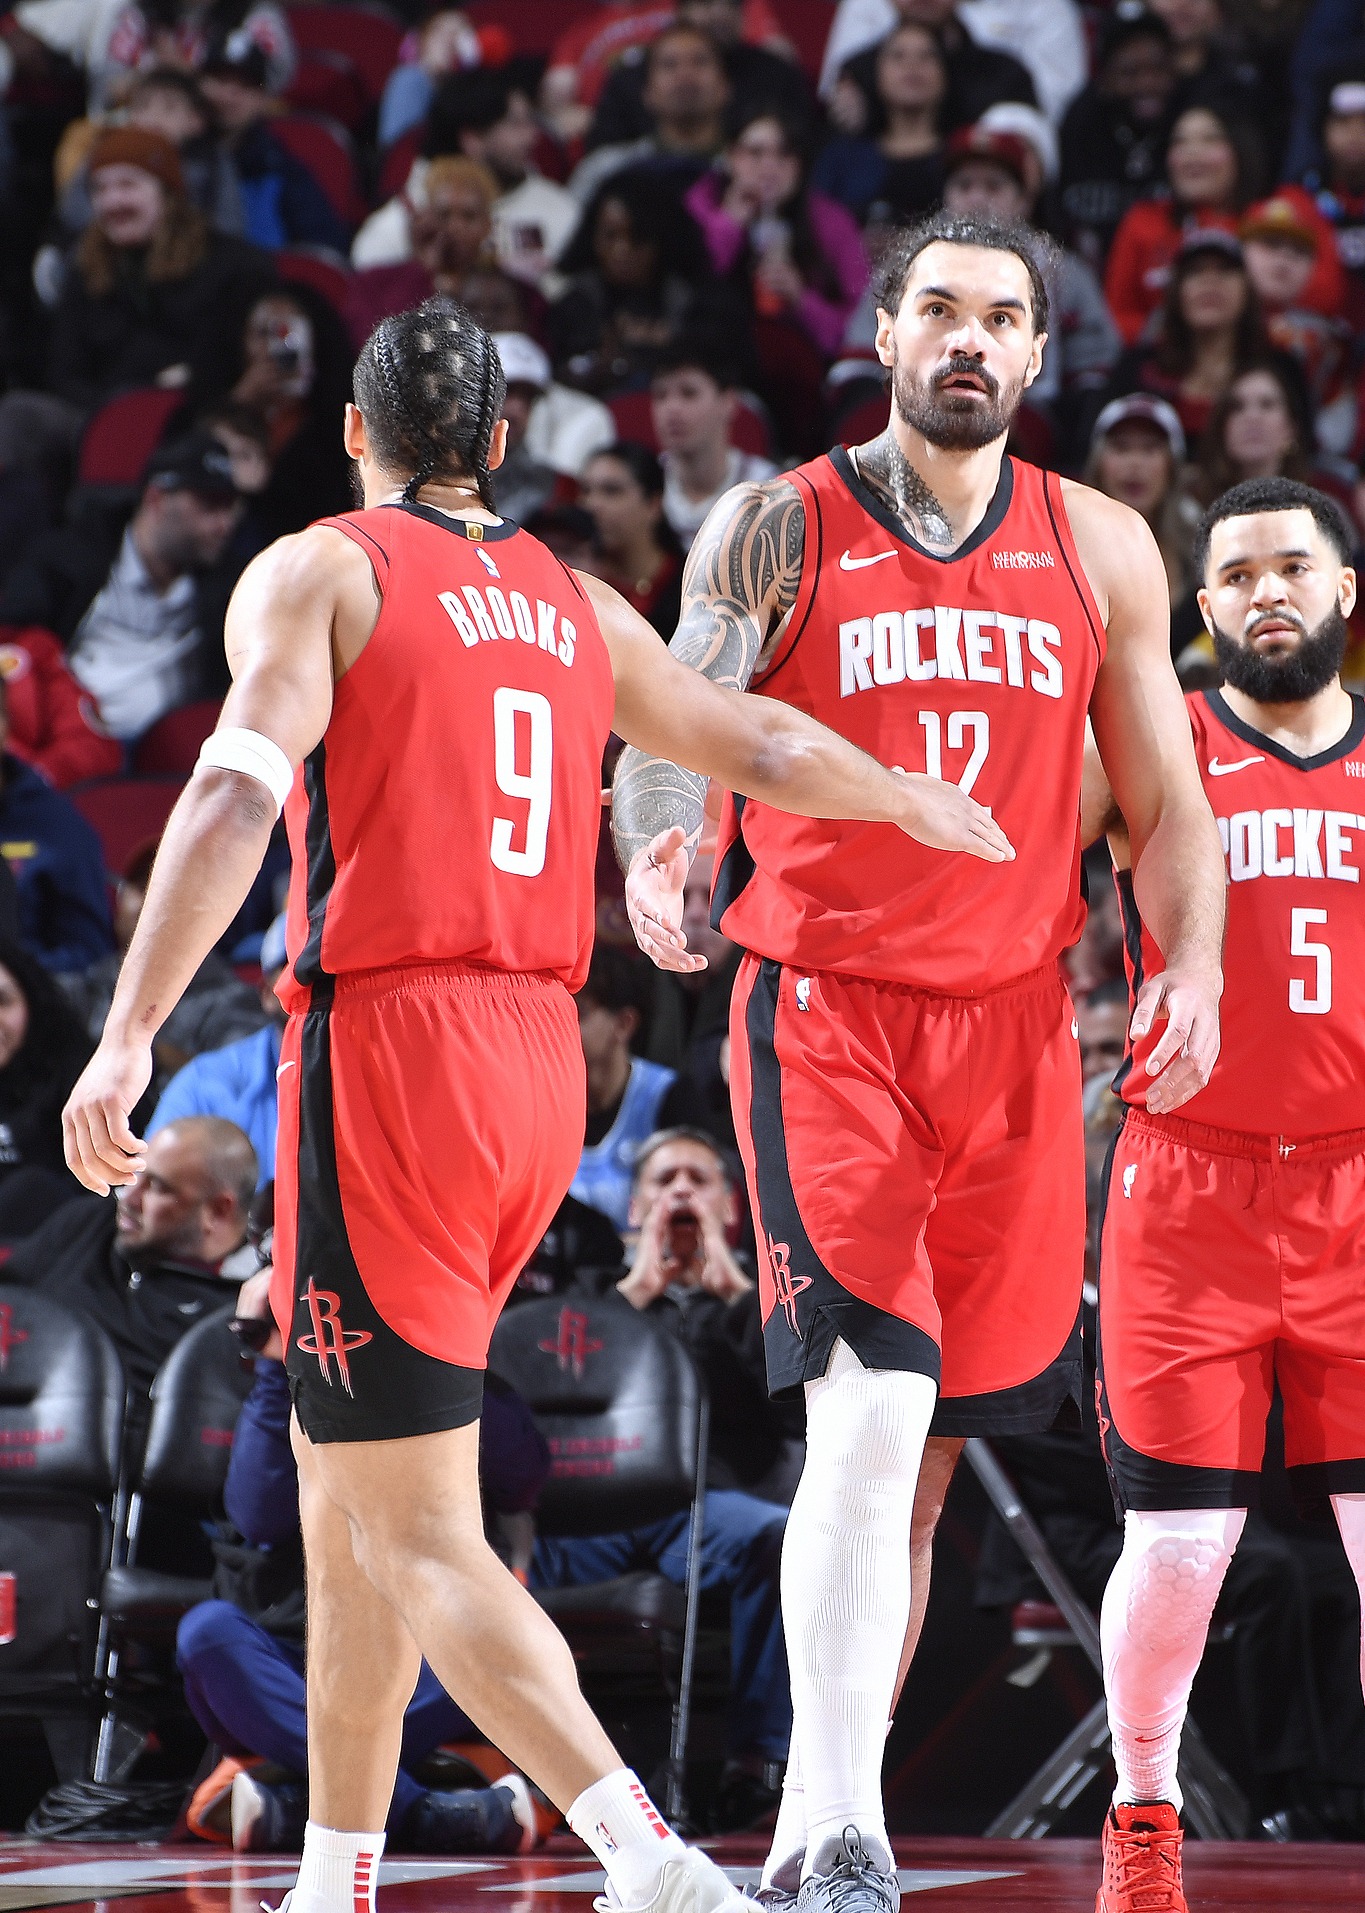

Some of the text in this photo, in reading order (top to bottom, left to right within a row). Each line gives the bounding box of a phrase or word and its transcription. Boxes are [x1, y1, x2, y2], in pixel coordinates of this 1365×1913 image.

[992, 551, 1054, 562] MEMORIAL
[993, 559, 1055, 569] HERMANN
[436, 584, 577, 668] BROOKS
[839, 605, 1063, 699] ROCKETS
[490, 686, 552, 878] 9
[918, 710, 992, 818] 12
[1216, 808, 1365, 886] OCKE
[1288, 907, 1332, 1014] 5
